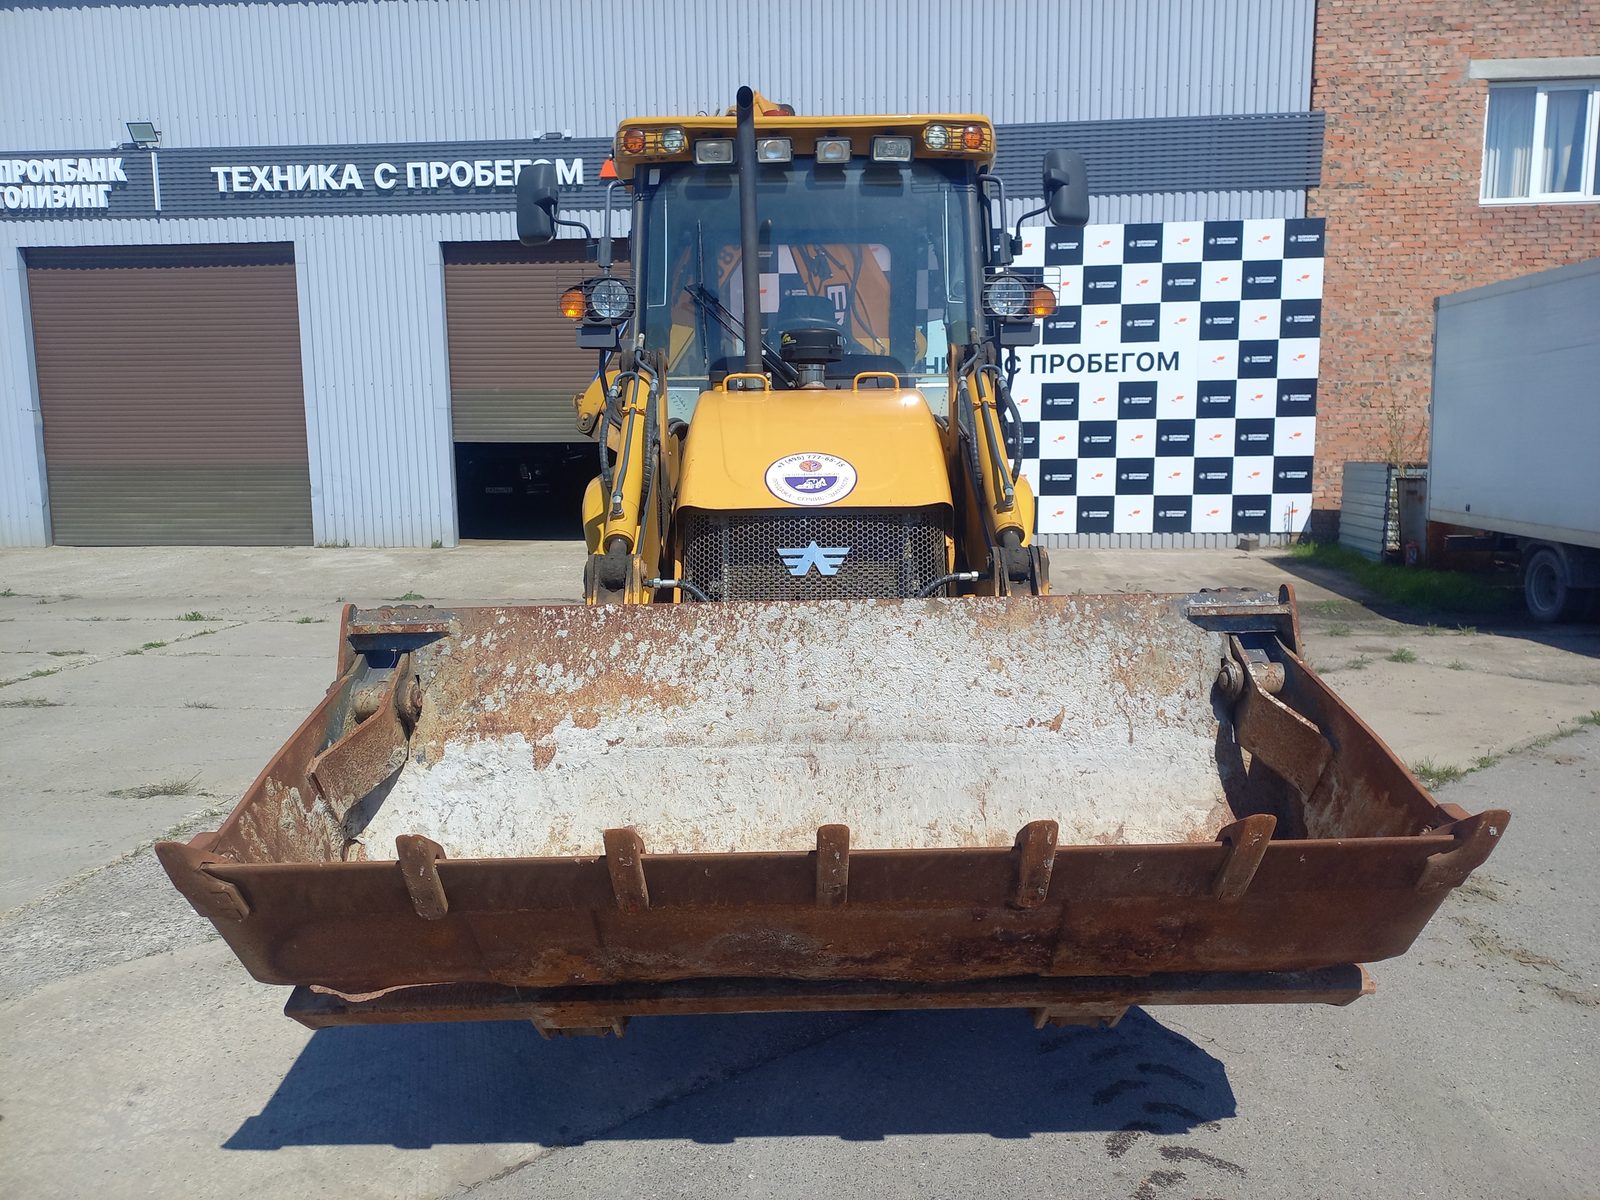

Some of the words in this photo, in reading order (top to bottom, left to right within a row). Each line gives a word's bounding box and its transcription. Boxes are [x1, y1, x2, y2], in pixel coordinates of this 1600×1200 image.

[0, 158, 127, 183] ПРОМБАНК
[210, 164, 364, 192] ТЕХНИКА
[374, 163, 398, 189] С
[406, 158, 584, 188] ПРОБЕГМ
[1030, 351, 1180, 374] ПРОБЕГОМ
